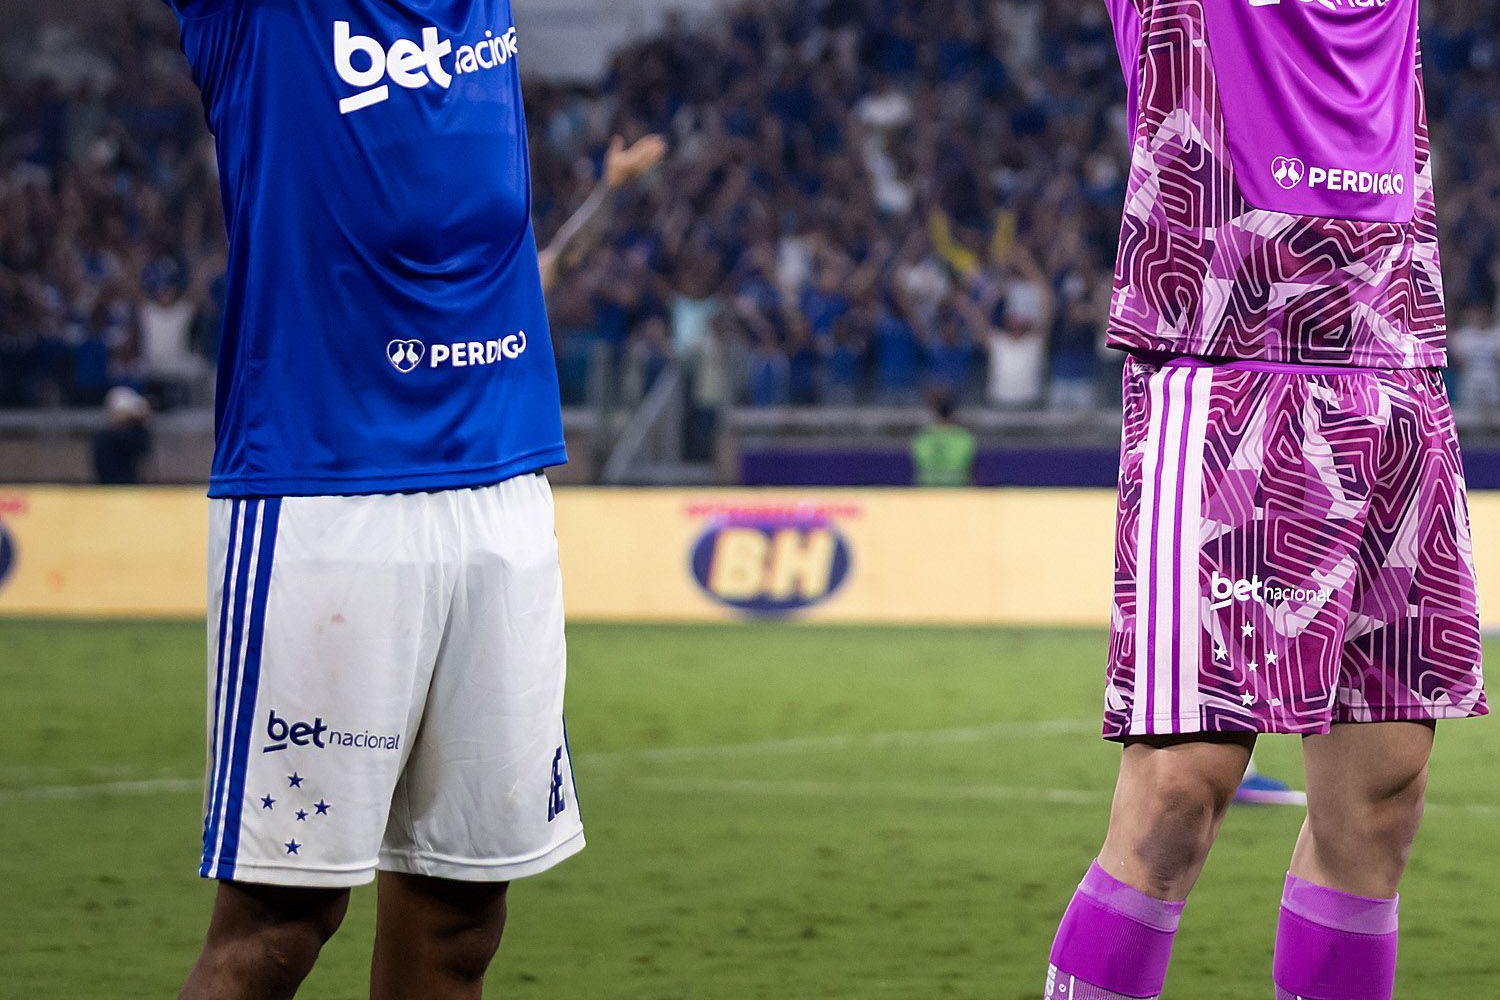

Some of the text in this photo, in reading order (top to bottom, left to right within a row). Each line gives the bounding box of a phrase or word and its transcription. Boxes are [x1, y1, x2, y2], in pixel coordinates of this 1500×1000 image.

[334, 20, 453, 90] bet
[708, 528, 832, 602] BH
[1210, 570, 1333, 604] bet nacional
[267, 709, 400, 750] bet nacional
